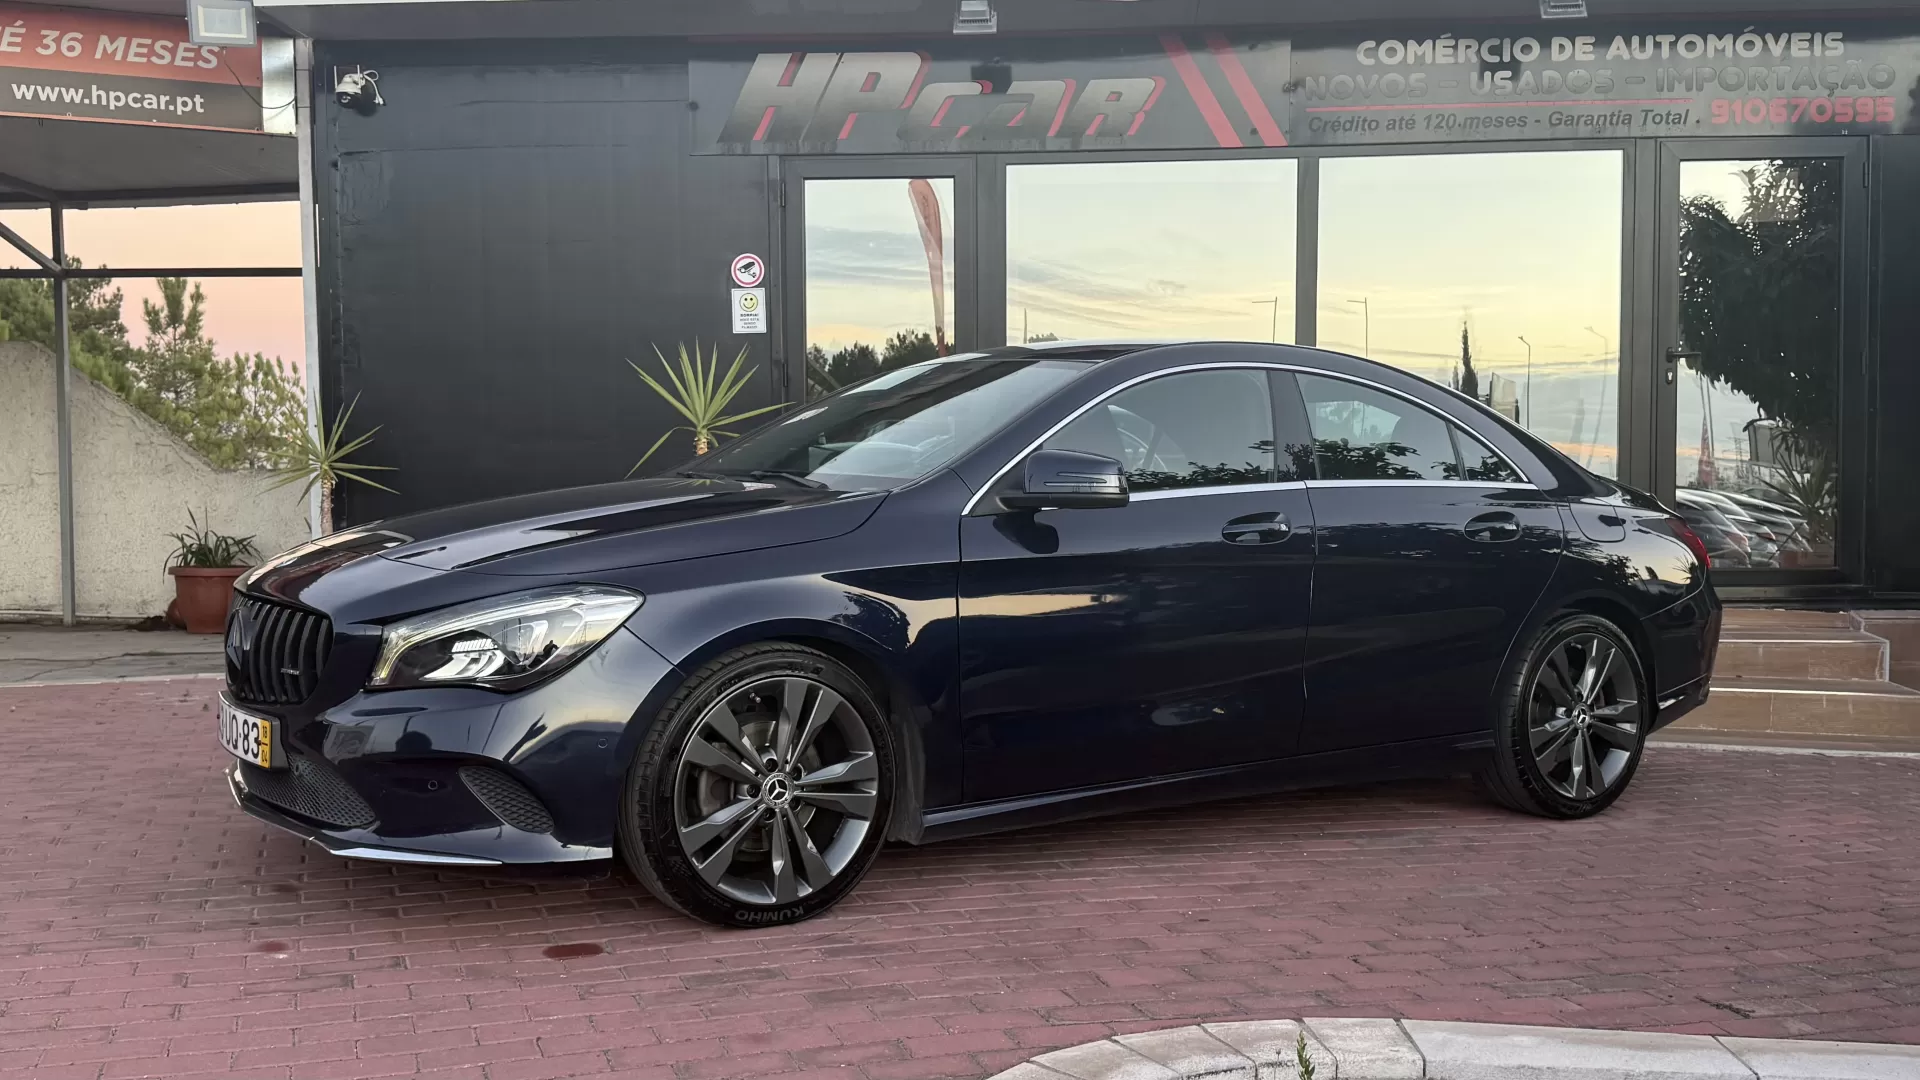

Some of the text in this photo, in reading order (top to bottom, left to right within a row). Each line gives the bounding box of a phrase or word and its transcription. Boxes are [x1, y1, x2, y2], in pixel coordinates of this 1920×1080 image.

[0, 20, 219, 69] É 36 MESES
[1356, 26, 1845, 66] COMÉRCIO DE AUTOMÓVEIS
[1305, 73, 1429, 100] NOVOS
[1470, 69, 1615, 97] USADOS
[1655, 59, 1896, 97] IMPORTAÇÃO
[11, 83, 205, 115] www.hpcar.pt
[1308, 115, 1380, 133] Crédito
[1386, 114, 1416, 131] até
[1462, 115, 1528, 129] meses
[1548, 110, 1632, 127] Garantia
[1641, 109, 1690, 126] Total
[1711, 97, 1896, 125] 910670595
[734, 906, 804, 922] KUMHO
